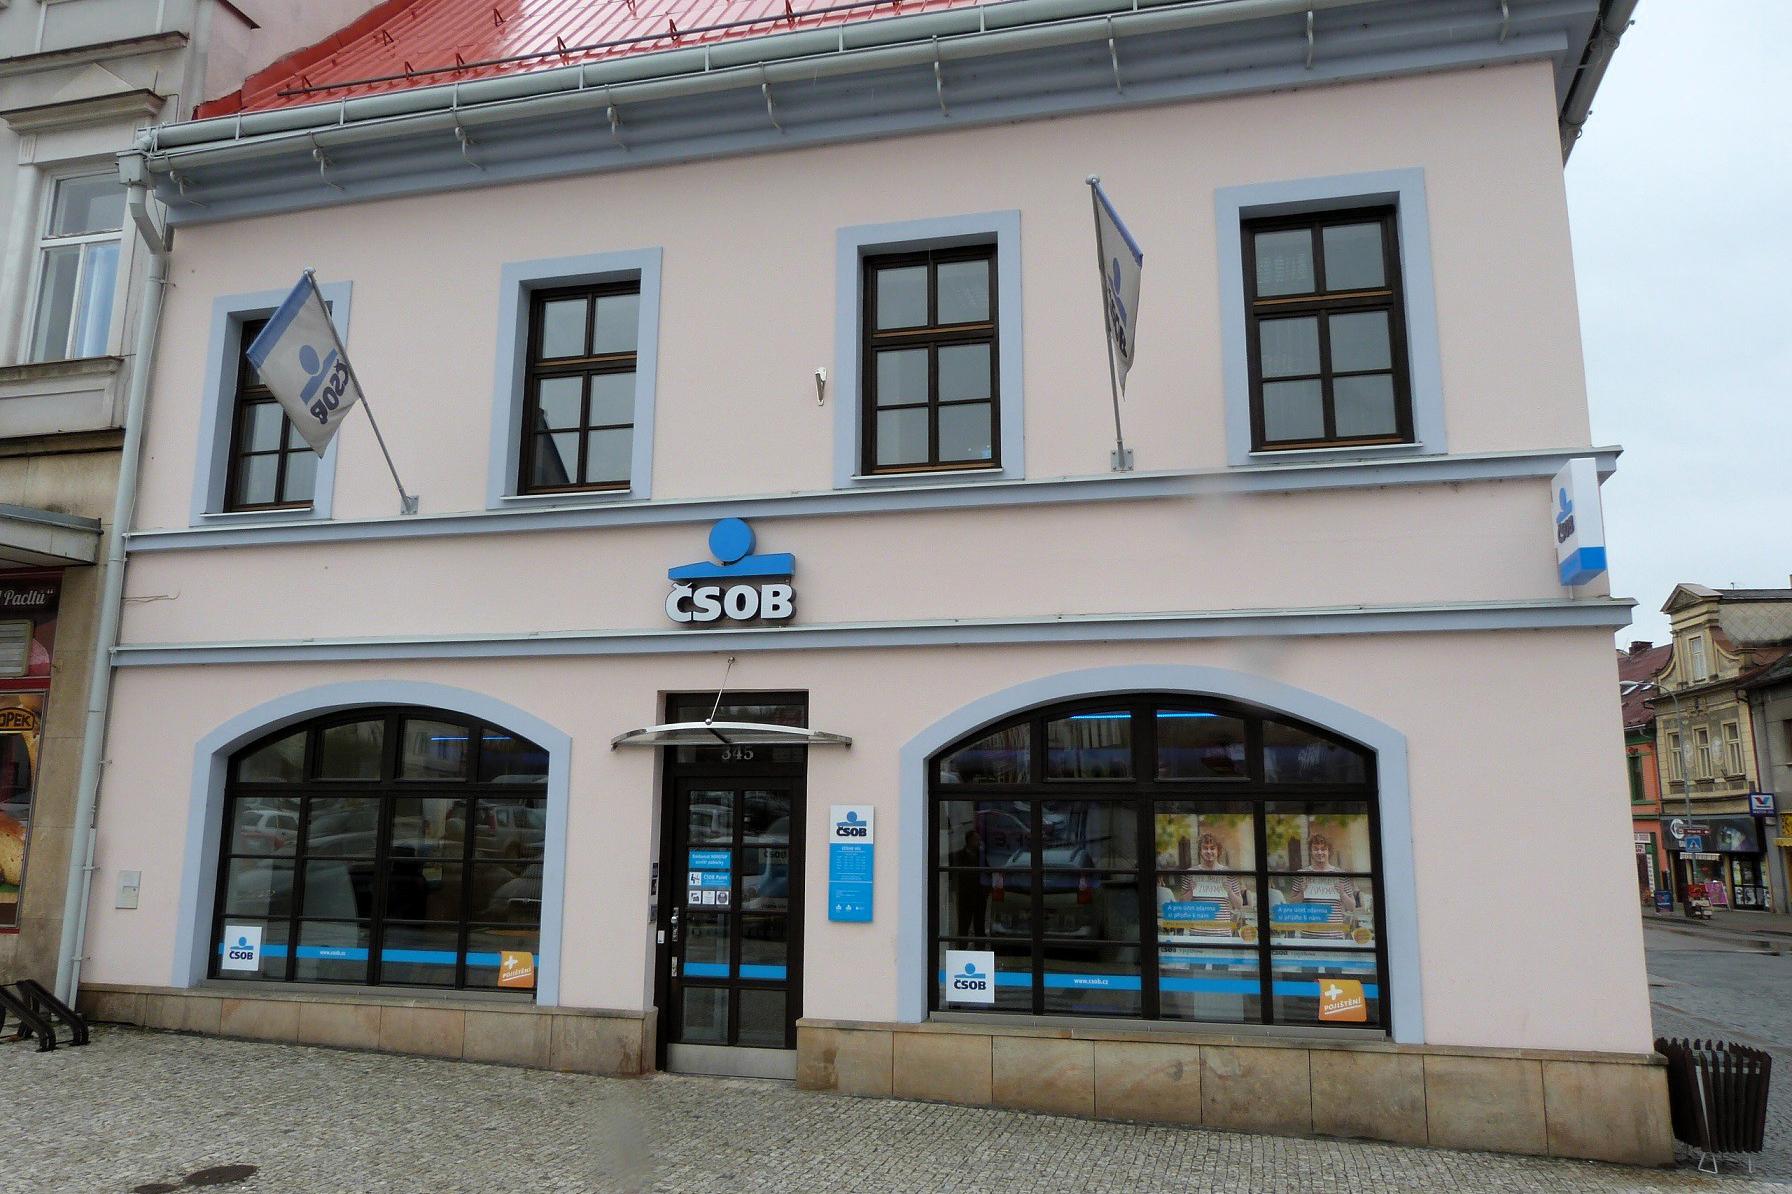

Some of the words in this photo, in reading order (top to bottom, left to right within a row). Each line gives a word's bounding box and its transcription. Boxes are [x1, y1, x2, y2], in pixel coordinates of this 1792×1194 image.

[664, 582, 796, 624] ČSOB
[836, 826, 867, 837] ČSOB
[229, 950, 254, 960] ČSOB
[954, 978, 987, 991] ČSOB
[1324, 996, 1361, 1012] POJIŠTĚNÍ
